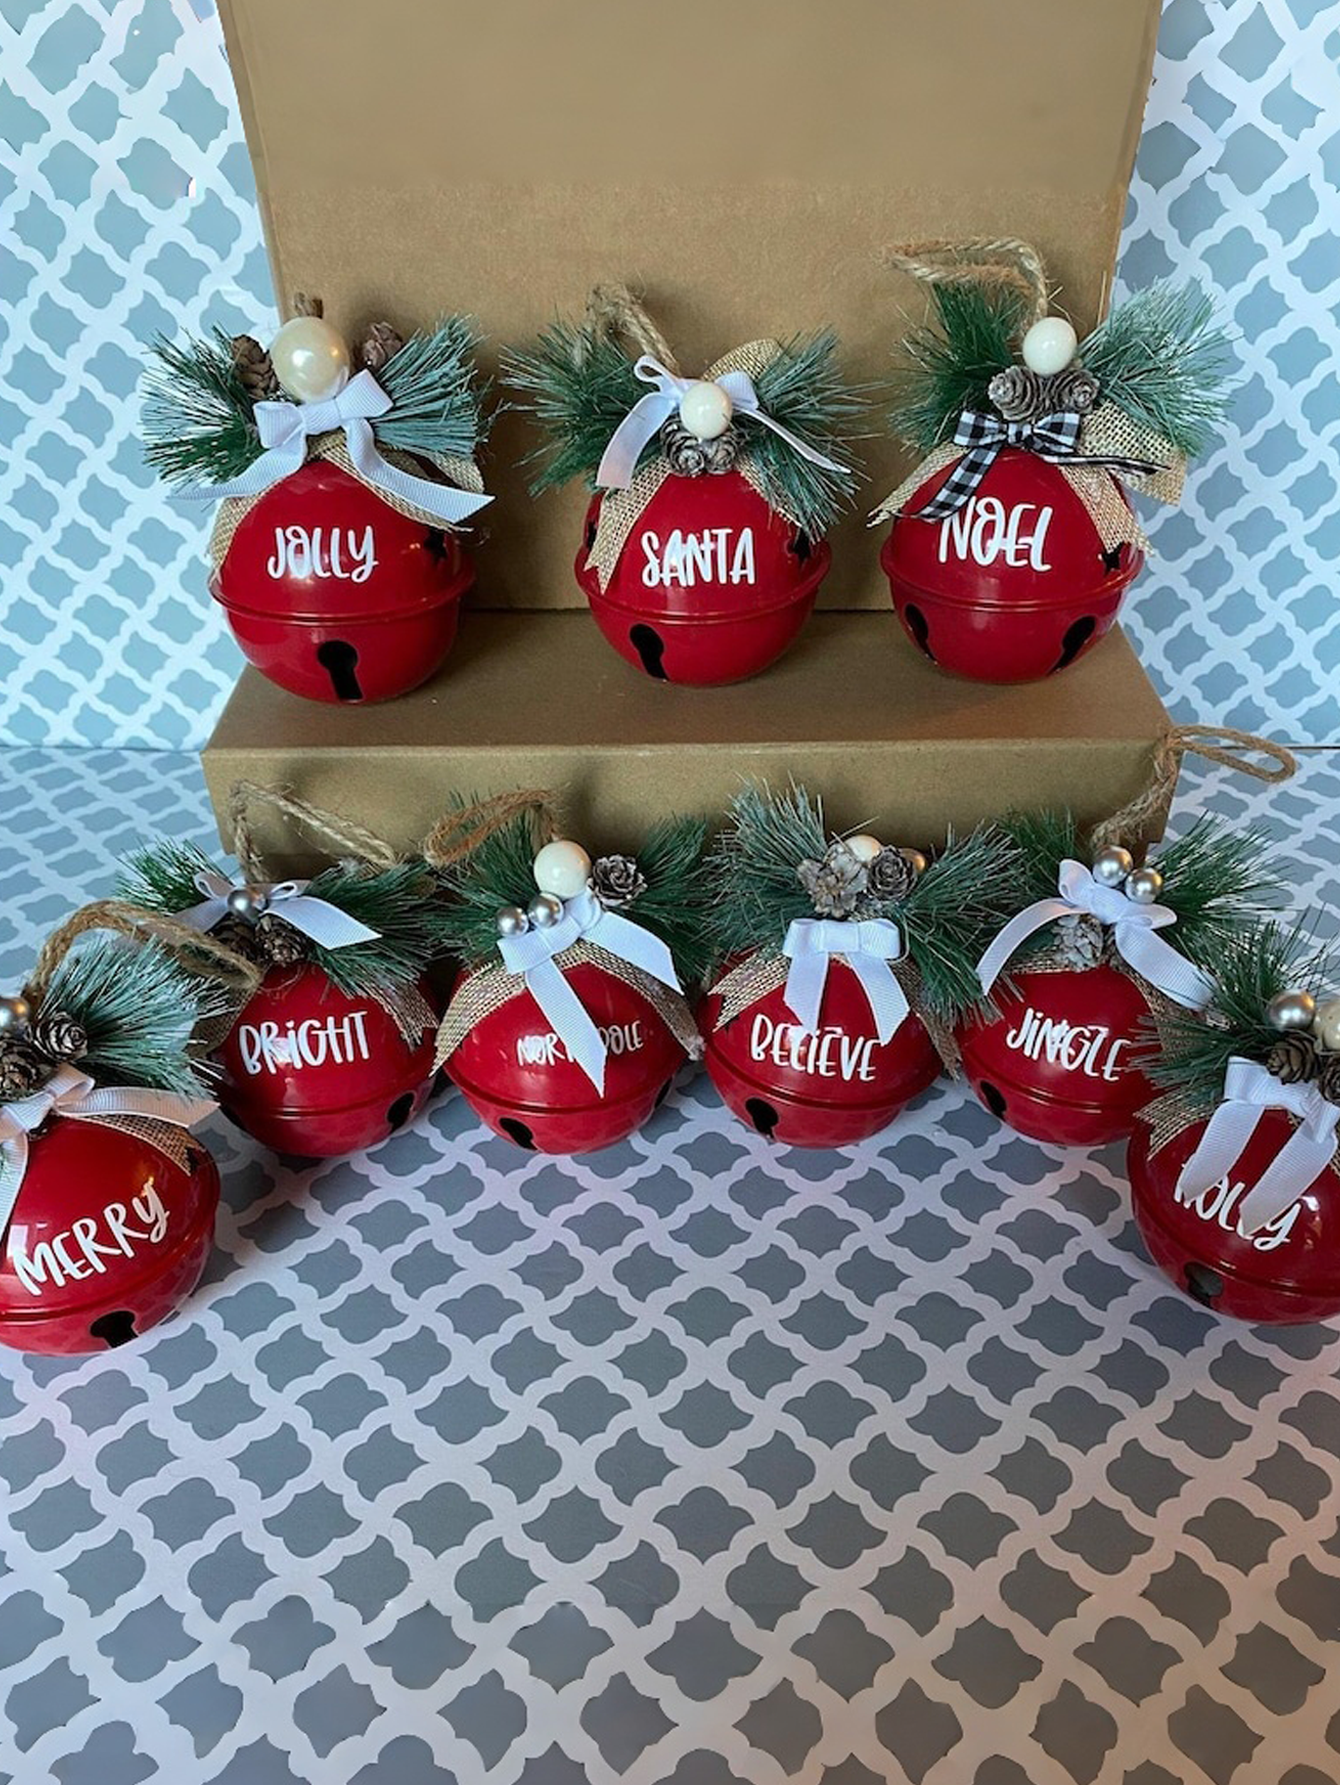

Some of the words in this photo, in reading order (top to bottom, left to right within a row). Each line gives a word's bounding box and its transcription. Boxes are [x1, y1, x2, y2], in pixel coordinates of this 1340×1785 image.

[267, 525, 378, 583] JOLLY
[641, 528, 756, 587] SANTA
[939, 496, 1053, 572] NOEL
[517, 1032, 576, 1066] NOR
[12, 1181, 170, 1296] MERRY
